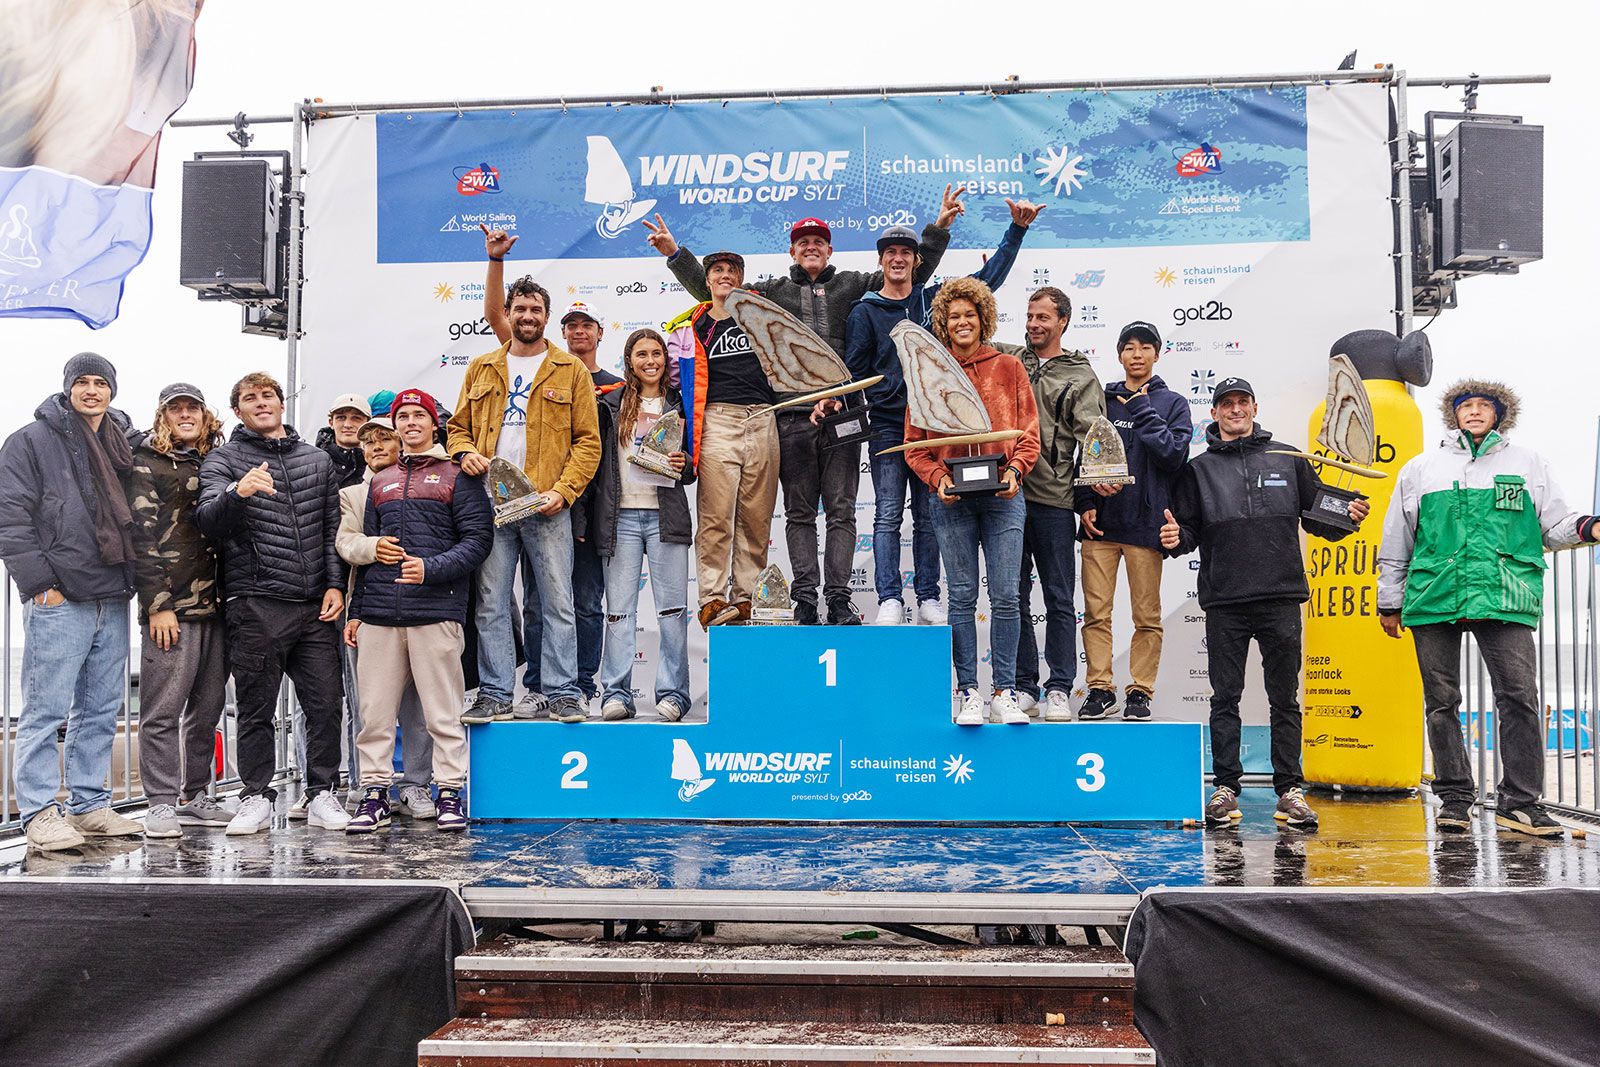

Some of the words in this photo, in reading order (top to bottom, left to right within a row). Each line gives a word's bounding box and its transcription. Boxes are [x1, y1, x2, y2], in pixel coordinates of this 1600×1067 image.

[638, 150, 850, 186] WINDSURF
[880, 154, 1023, 174] schauinsland
[1182, 155, 1217, 168] PWA
[462, 175, 495, 187] PWA
[956, 176, 1023, 195] reisen
[679, 188, 753, 205] WORLD
[755, 185, 798, 202] CUP
[803, 184, 846, 201] SYLT
[1181, 196, 1208, 204] World
[1210, 194, 1240, 205] Sailing
[1181, 205, 1213, 215] Special
[1215, 203, 1241, 213] Event
[461, 213, 487, 222] World
[488, 212, 517, 223] Sailing
[847, 217, 863, 231] by
[867, 209, 917, 231] got2b
[492, 220, 517, 231] Event
[1183, 264, 1251, 276] schauinsland
[1183, 276, 1216, 286] reisen
[616, 281, 648, 296] got2b
[1172, 300, 1233, 327] got2b
[448, 317, 496, 341] got2
[1306, 654, 1331, 666] Freeze
[817, 648, 837, 687] 1
[1306, 668, 1343, 680] Haarlack
[1334, 688, 1352, 696] Looks
[704, 752, 833, 772] WINDSURF
[850, 757, 937, 770] schauinsland
[560, 750, 589, 790] 2
[1075, 752, 1106, 793] 3
[728, 772, 774, 784] WORLD
[775, 772, 801, 784] CUP
[803, 772, 830, 784] SYLT
[895, 771, 937, 784] reisen
[791, 792, 830, 802] presented
[830, 792, 840, 803] by
[841, 789, 873, 803] got2b
